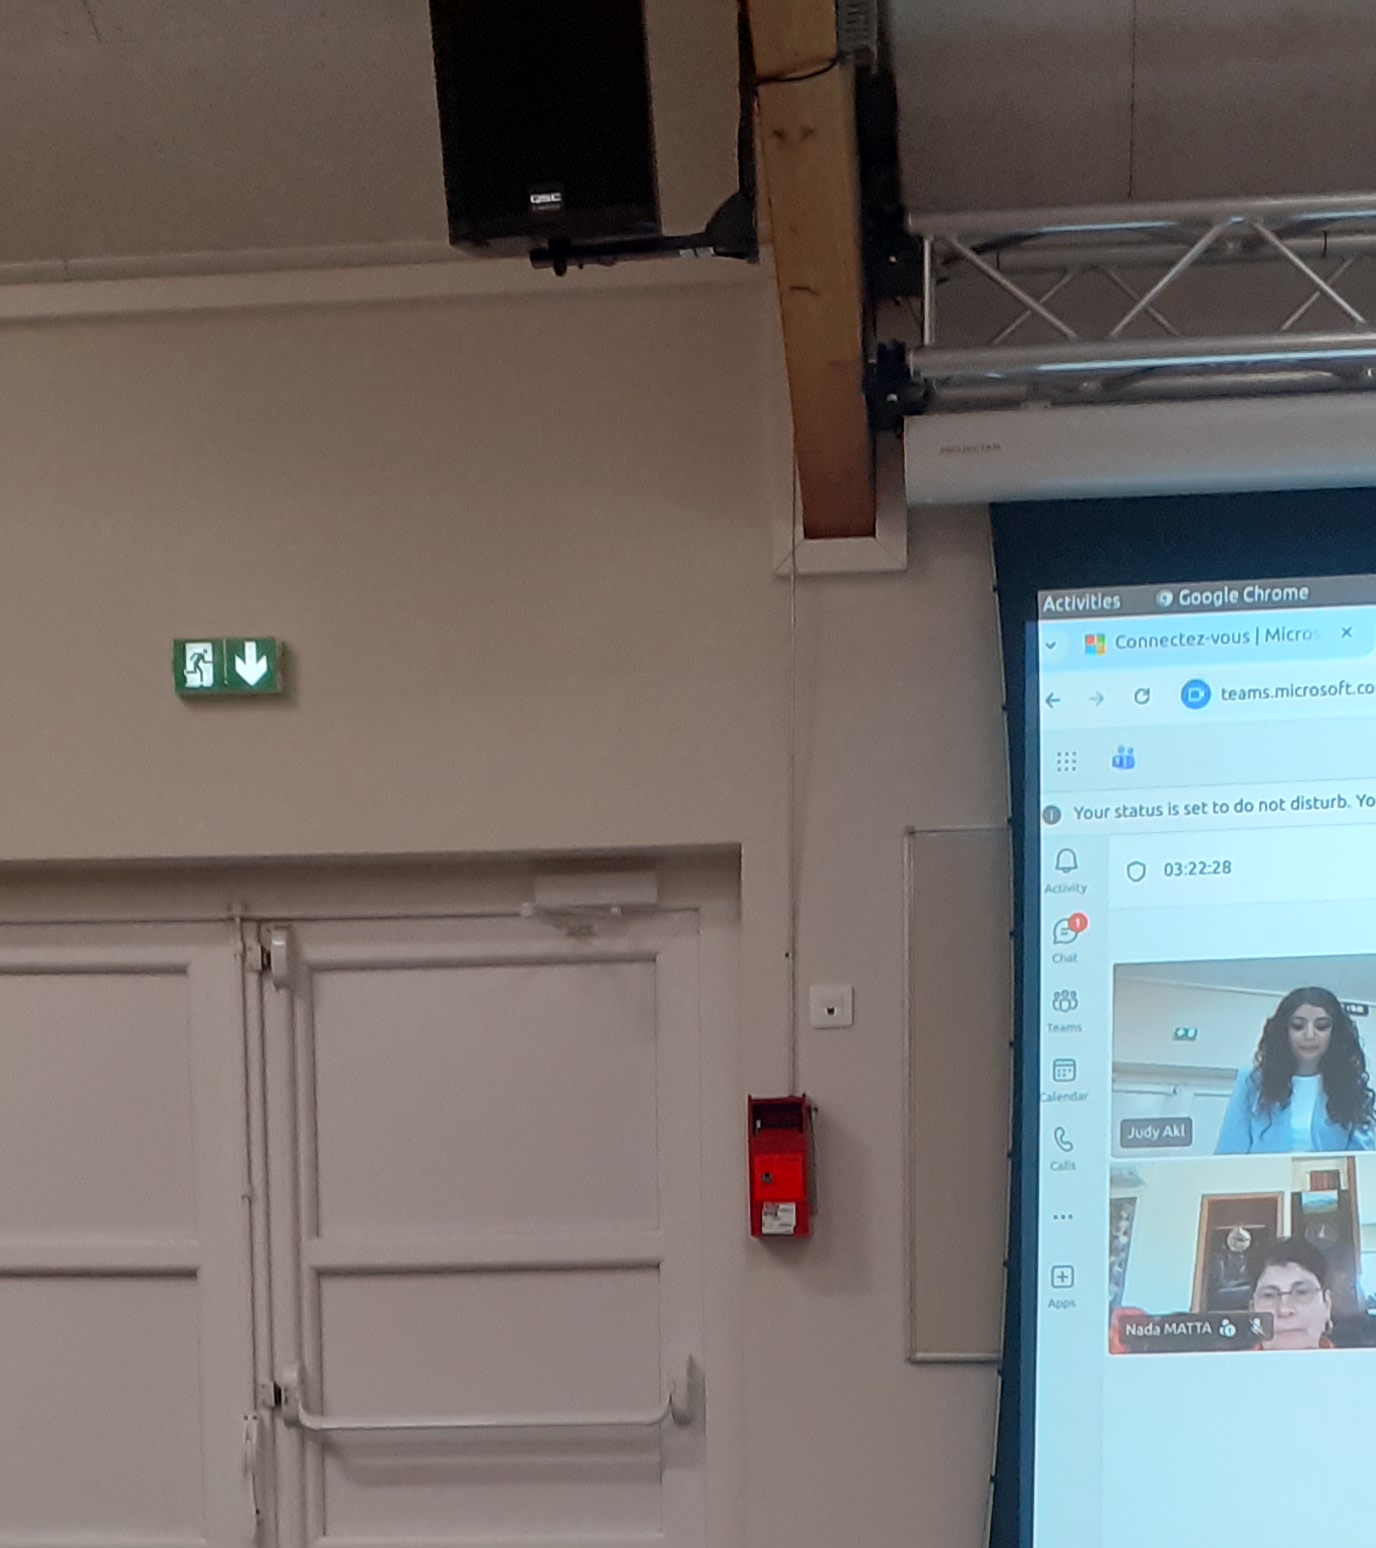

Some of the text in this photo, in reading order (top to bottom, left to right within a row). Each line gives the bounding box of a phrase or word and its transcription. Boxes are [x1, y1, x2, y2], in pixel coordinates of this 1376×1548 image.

[1042, 593, 1121, 612] Activities
[1179, 584, 1310, 606] Google Chrome
[1114, 629, 1251, 650] Connectez-vous
[1074, 805, 1110, 820] Your
[1114, 803, 1163, 819] status
[1168, 802, 1180, 817] is
[1184, 801, 1208, 816] set
[1212, 800, 1229, 815] to
[1233, 798, 1255, 814] do
[1259, 798, 1286, 813] not
[1290, 795, 1351, 811] disturb.
[1163, 860, 1232, 877] 03:22:28
[1044, 883, 1088, 895] Activity
[1052, 953, 1078, 964] Chat
[1047, 1022, 1083, 1033] Teams
[1040, 1091, 1088, 1103] Calendar
[1127, 1124, 1186, 1141] Judy Akl
[1050, 1160, 1077, 1171] Calls
[1047, 1298, 1077, 1310] Apps
[1126, 1321, 1213, 1337] Nada MATTA
